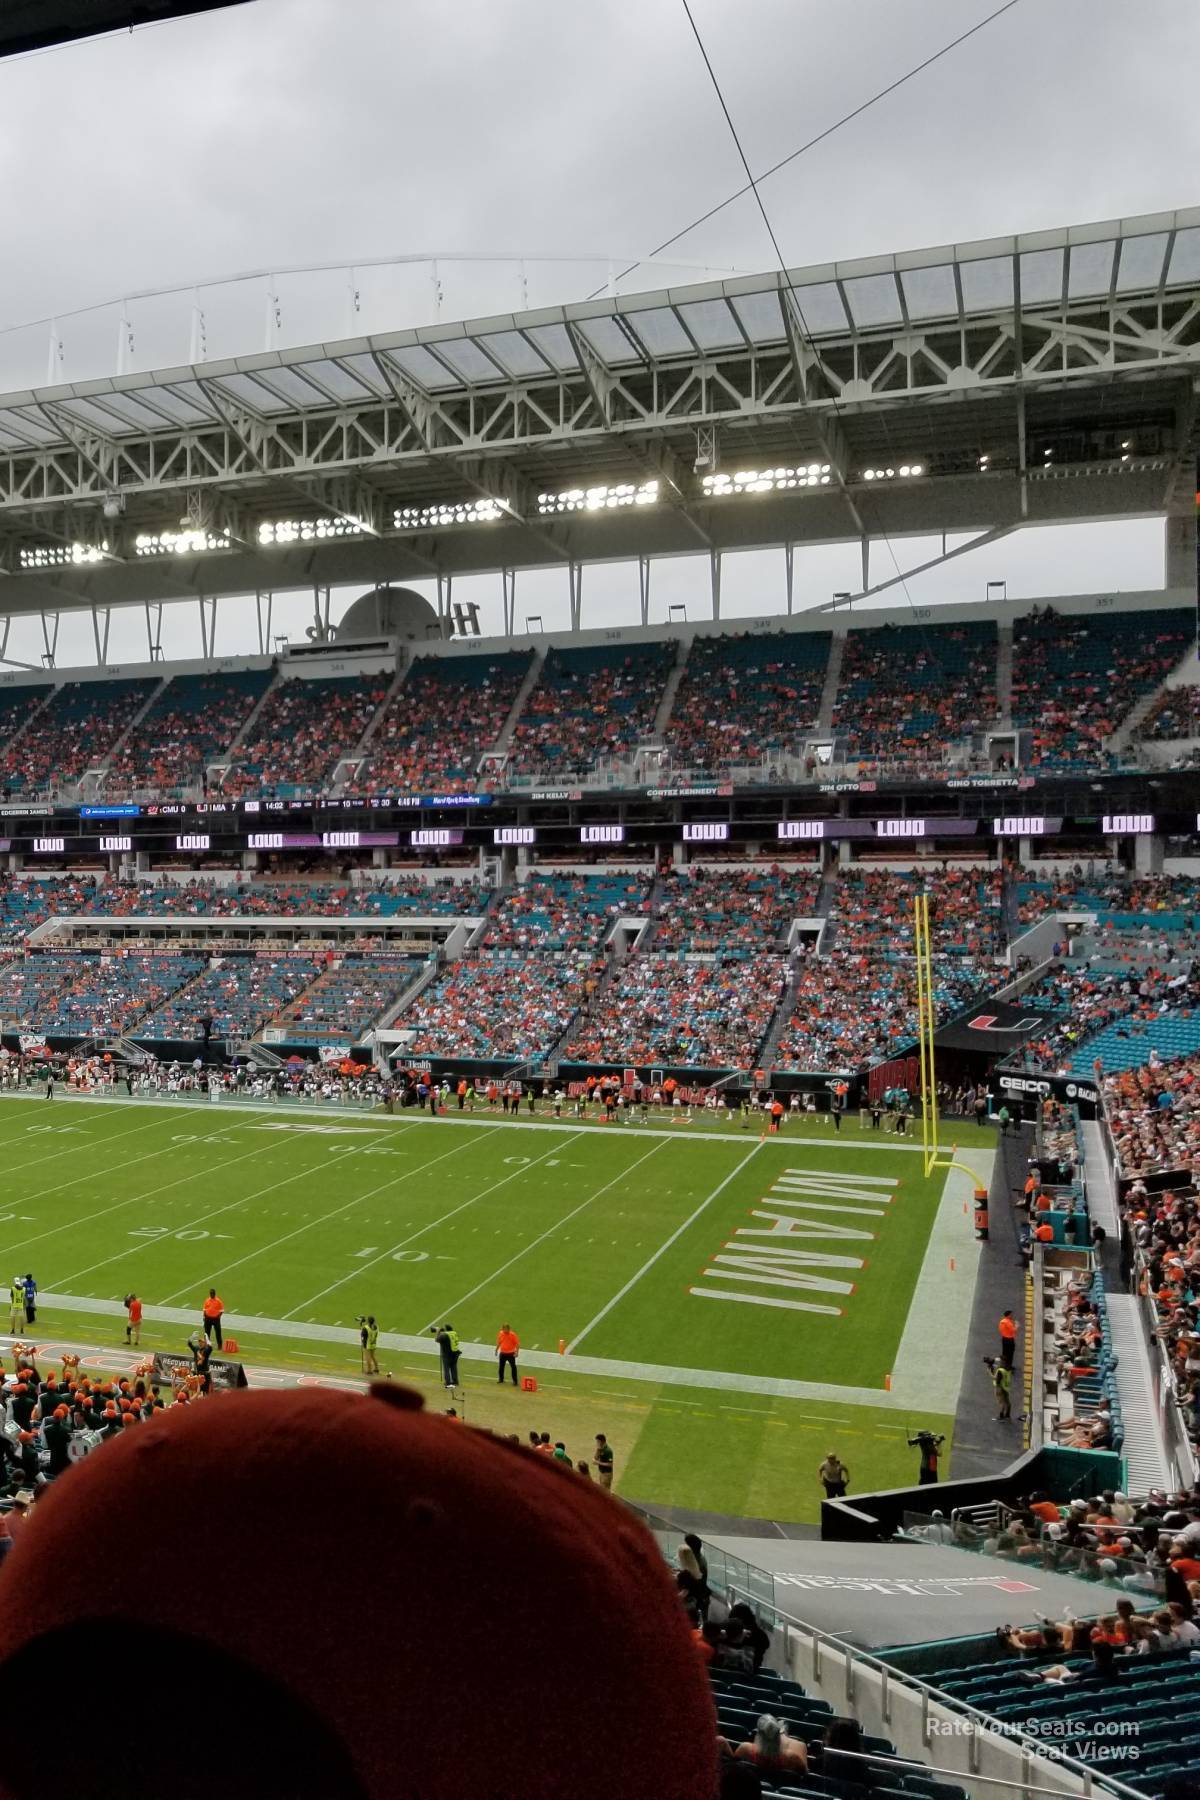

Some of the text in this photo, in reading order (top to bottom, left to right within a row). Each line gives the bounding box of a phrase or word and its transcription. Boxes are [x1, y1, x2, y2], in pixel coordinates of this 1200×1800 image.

[836, 783, 860, 791] OTTO
[162, 805, 179, 813] CMU
[213, 804, 226, 812] MIA
[266, 802, 284, 810] 14:02
[683, 824, 727, 839] LOUD
[779, 822, 824, 838] LOUD
[878, 820, 925, 836] LOUD
[994, 818, 1044, 834] LOUD
[1103, 816, 1152, 832] LOUD
[248, 834, 282, 847] LOUD
[323, 833, 359, 846] LOUD
[412, 831, 450, 845] LOUD
[494, 829, 534, 844] LOUD
[581, 827, 623, 842] LOUD
[34, 839, 65, 851] LOUD
[100, 838, 131, 850] LOUD
[177, 836, 209, 849] LOUD
[1000, 1076, 1050, 1097] GEICO
[128, 1226, 211, 1241] 20
[689, 1168, 901, 1316] MIAMI
[347, 1247, 430, 1263] 10
[163, 1358, 190, 1368] RECOVER
